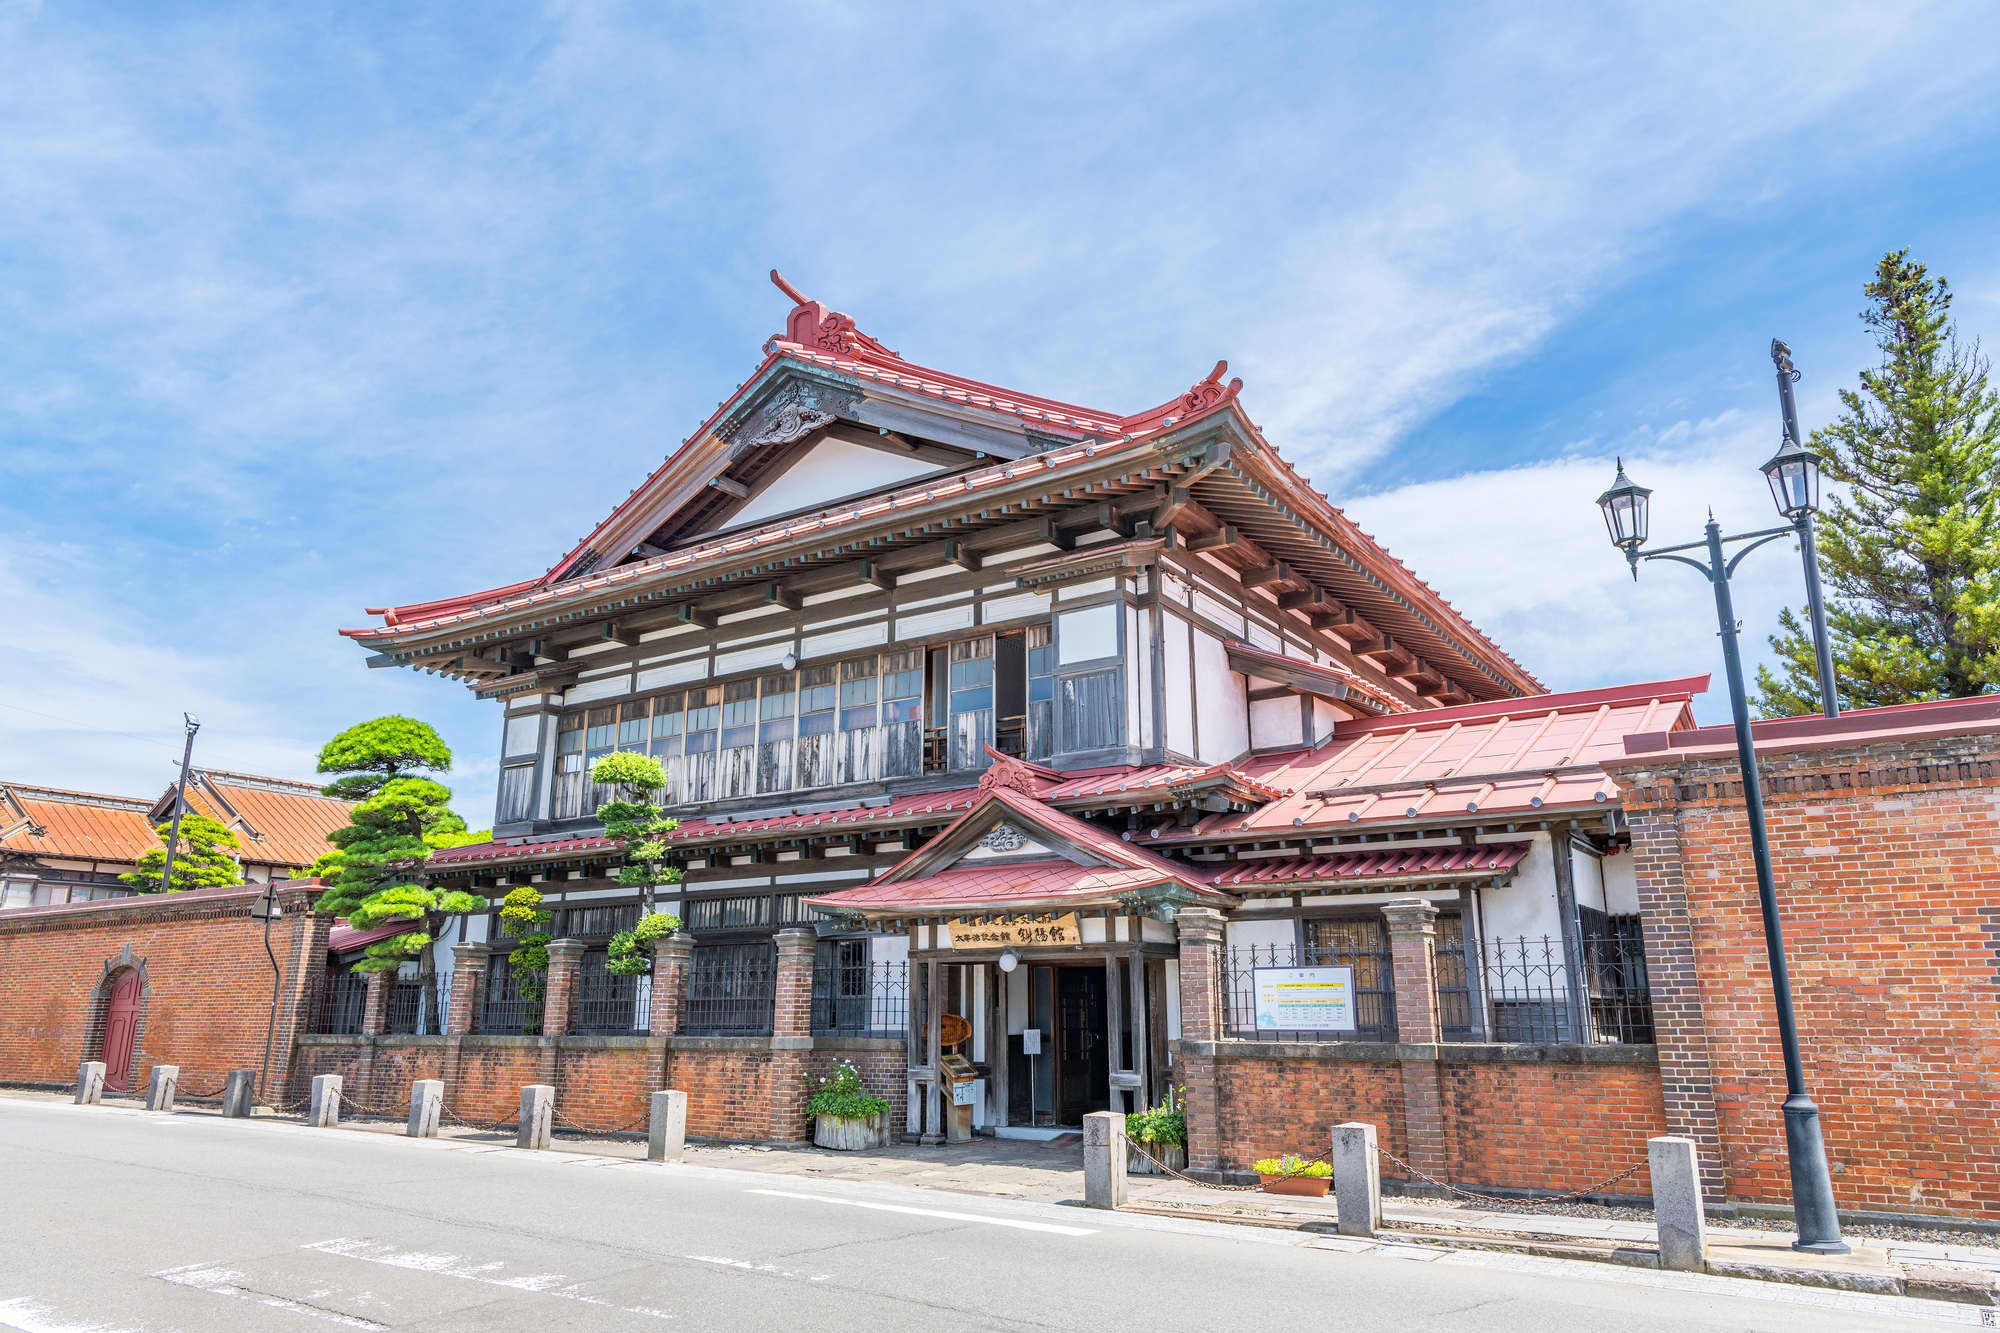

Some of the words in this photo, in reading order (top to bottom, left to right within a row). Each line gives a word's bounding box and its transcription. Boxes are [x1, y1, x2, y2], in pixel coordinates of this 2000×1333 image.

[955, 932, 1011, 942] 太宰治記念館
